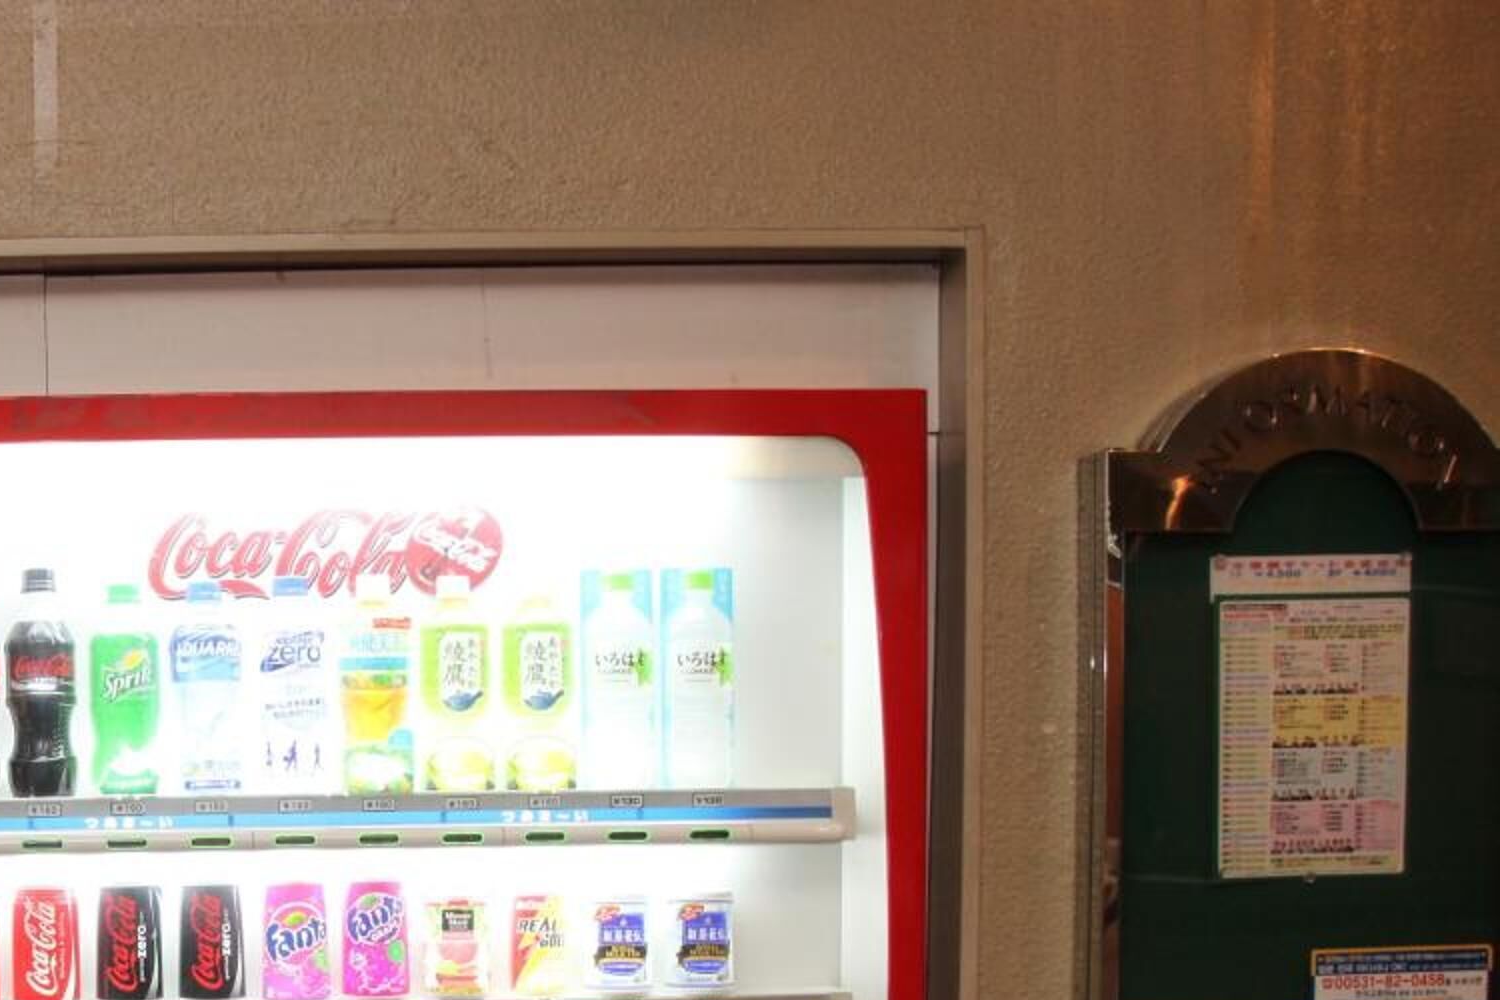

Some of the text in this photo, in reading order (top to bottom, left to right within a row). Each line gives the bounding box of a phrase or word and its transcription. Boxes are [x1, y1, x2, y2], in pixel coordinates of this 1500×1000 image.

[267, 645, 322, 663] zero
[105, 895, 139, 993] Coca-Cola
[137, 924, 147, 959] zero
[265, 916, 327, 962] Fanta
[518, 918, 558, 933] REAL
[24, 897, 58, 997] Coca-Cola
